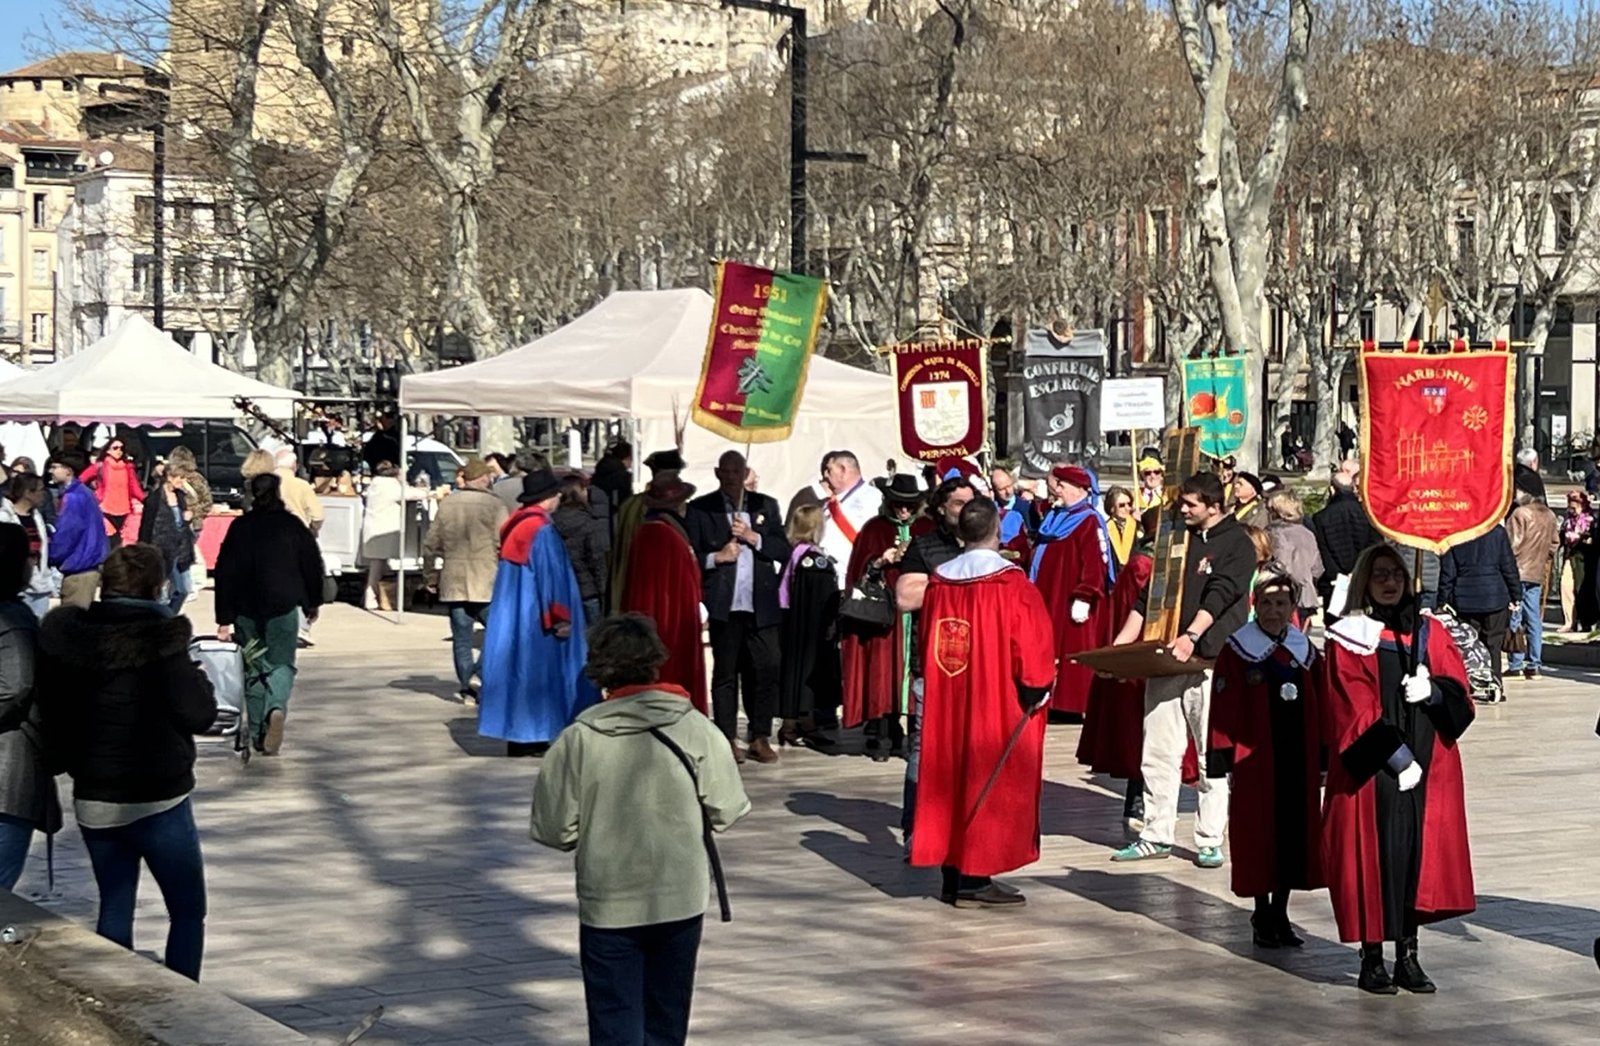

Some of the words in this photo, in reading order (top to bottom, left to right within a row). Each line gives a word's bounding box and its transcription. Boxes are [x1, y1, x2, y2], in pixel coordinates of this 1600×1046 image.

[753, 284, 788, 303] 1951
[1023, 361, 1100, 383] CONFRERIE
[1393, 367, 1477, 391] NARBONNE
[1029, 377, 1097, 398] ESCARGOT
[1042, 439, 1061, 453] DE
[1411, 501, 1472, 513] NARBONNE
